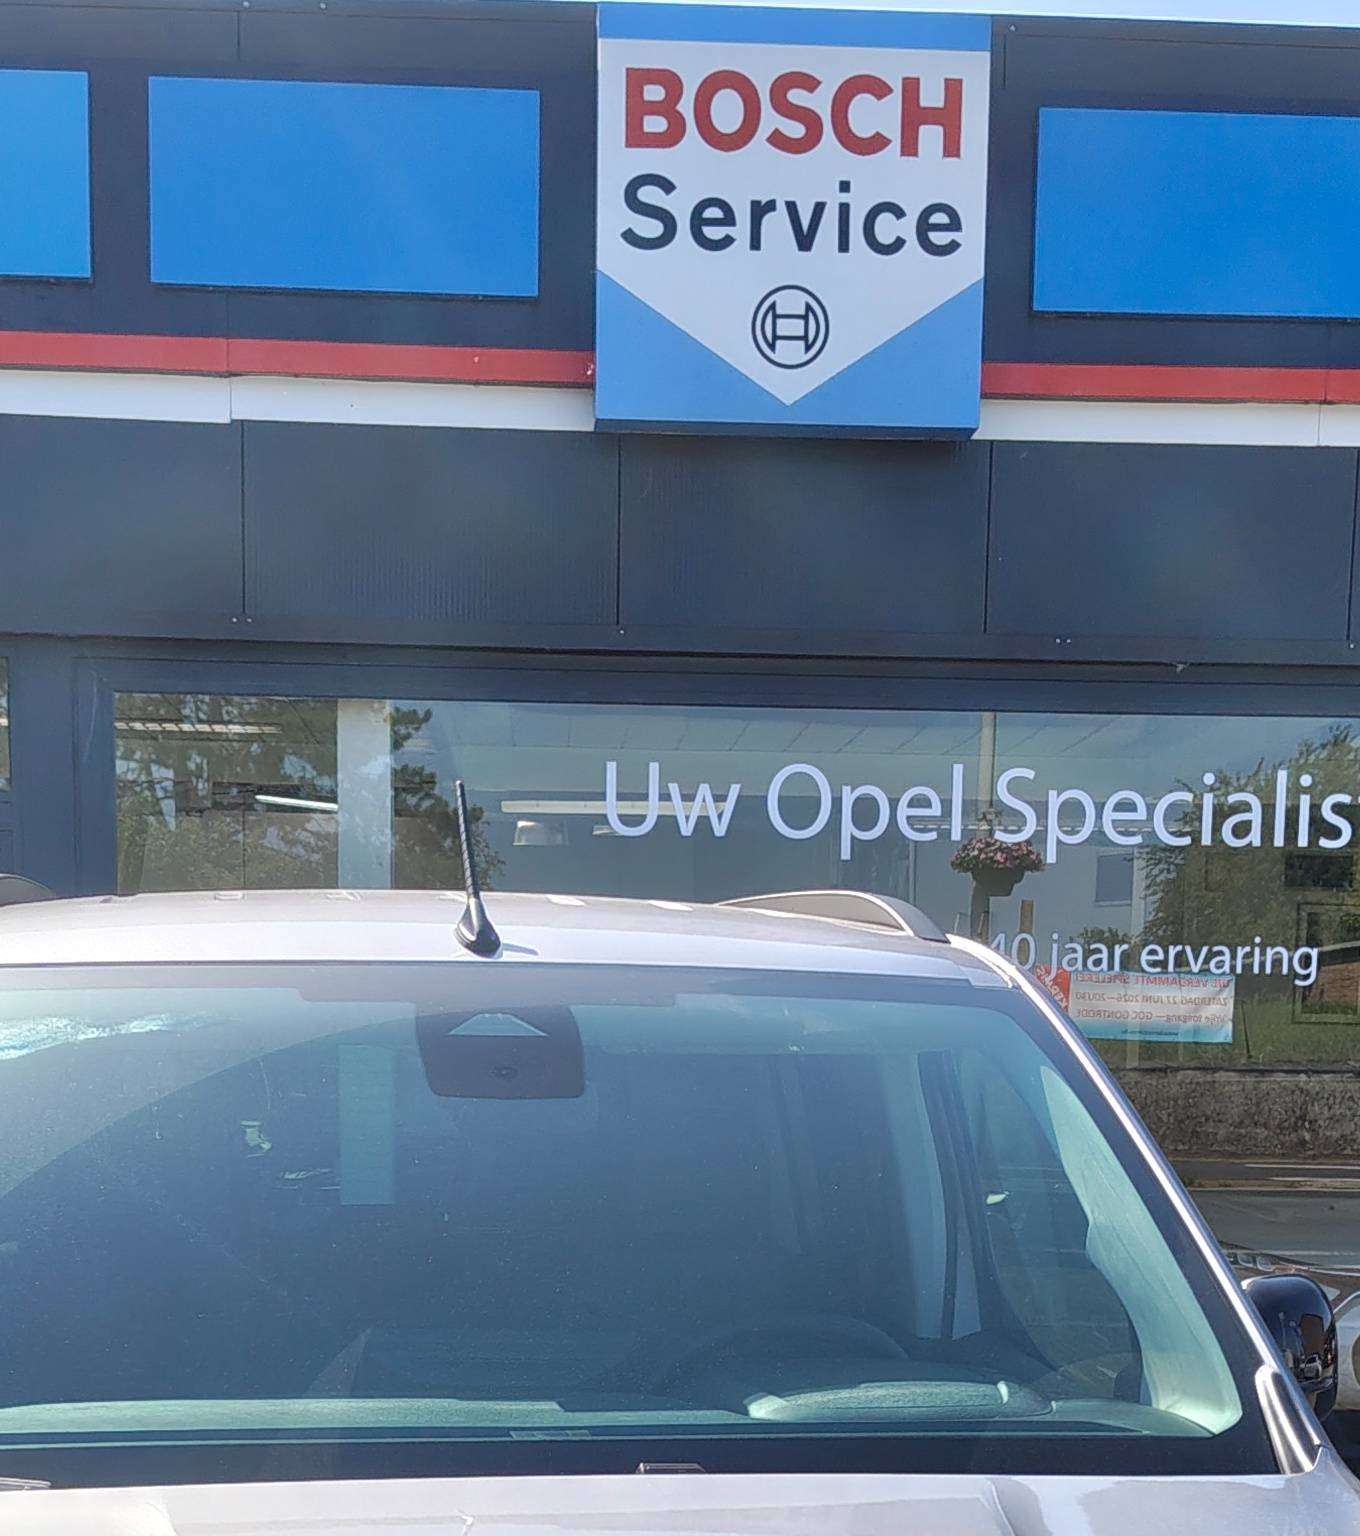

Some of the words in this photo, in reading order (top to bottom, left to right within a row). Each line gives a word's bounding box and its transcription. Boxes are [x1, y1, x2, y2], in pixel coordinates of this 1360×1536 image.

[624, 67, 964, 158] BOSCH
[620, 172, 963, 258] Service
[604, 760, 741, 839] Uw
[767, 761, 964, 861] Opel
[1048, 932, 1129, 984] jaar
[1140, 936, 1321, 987] ervaring
